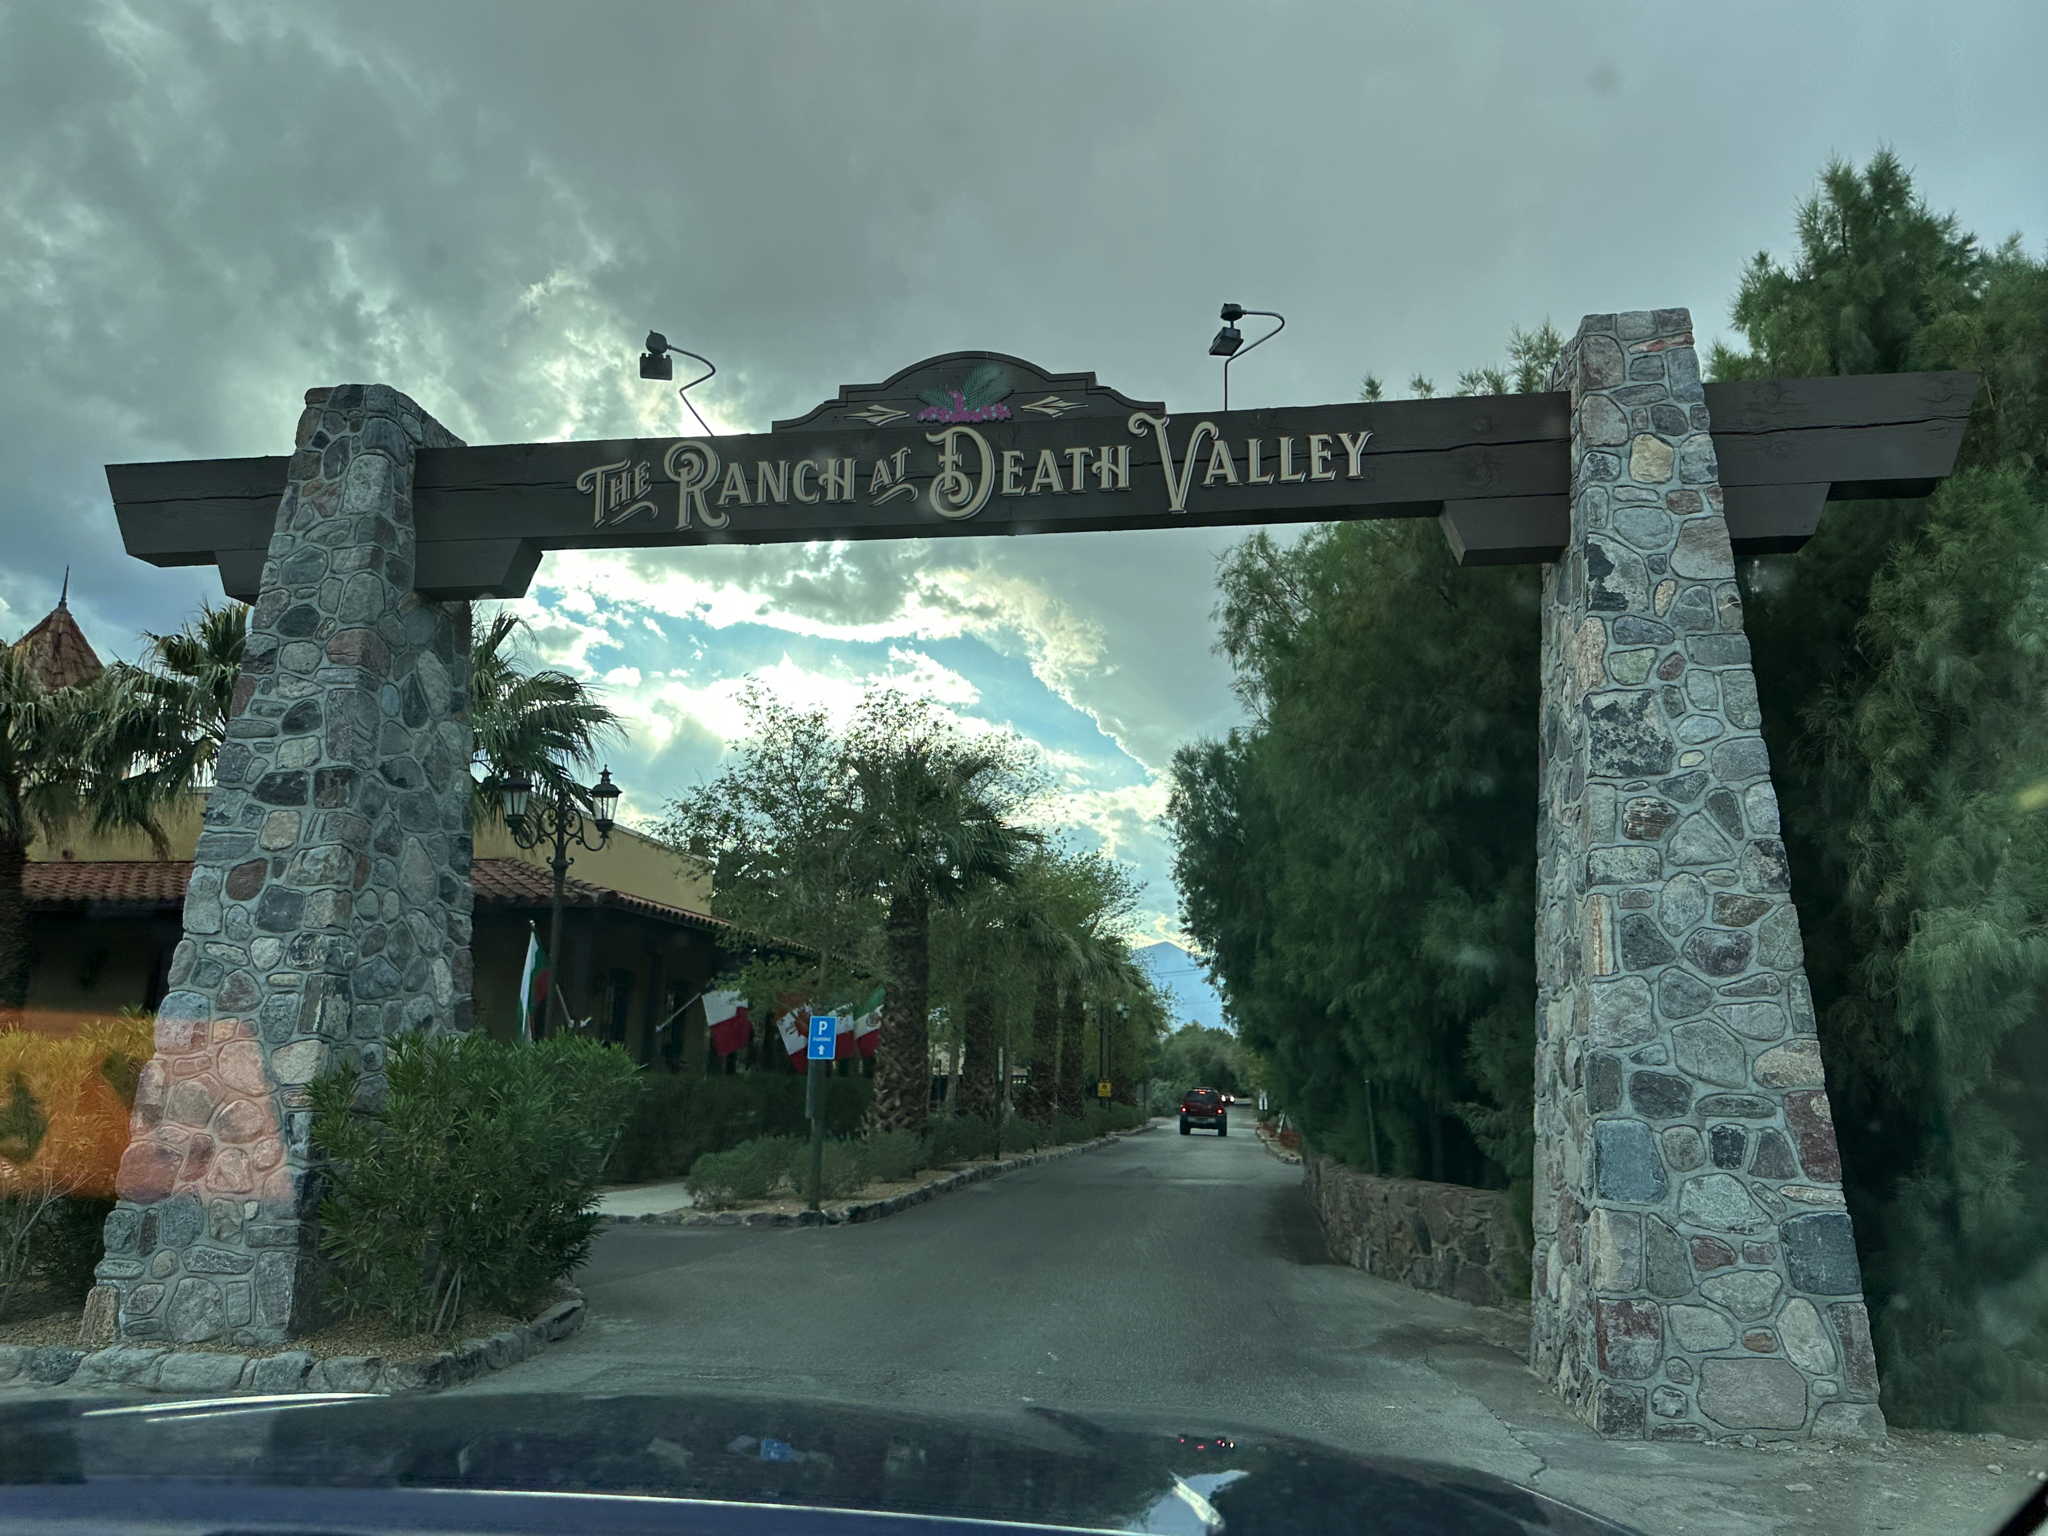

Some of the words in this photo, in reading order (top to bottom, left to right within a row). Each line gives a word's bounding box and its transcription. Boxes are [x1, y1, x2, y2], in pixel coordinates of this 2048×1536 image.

[575, 458, 659, 529] THE
[662, 439, 858, 532] RANCH
[868, 446, 919, 507] AT
[925, 425, 1132, 521] DEATH
[1127, 411, 1374, 514] VALLEY
[818, 1020, 828, 1036] P
